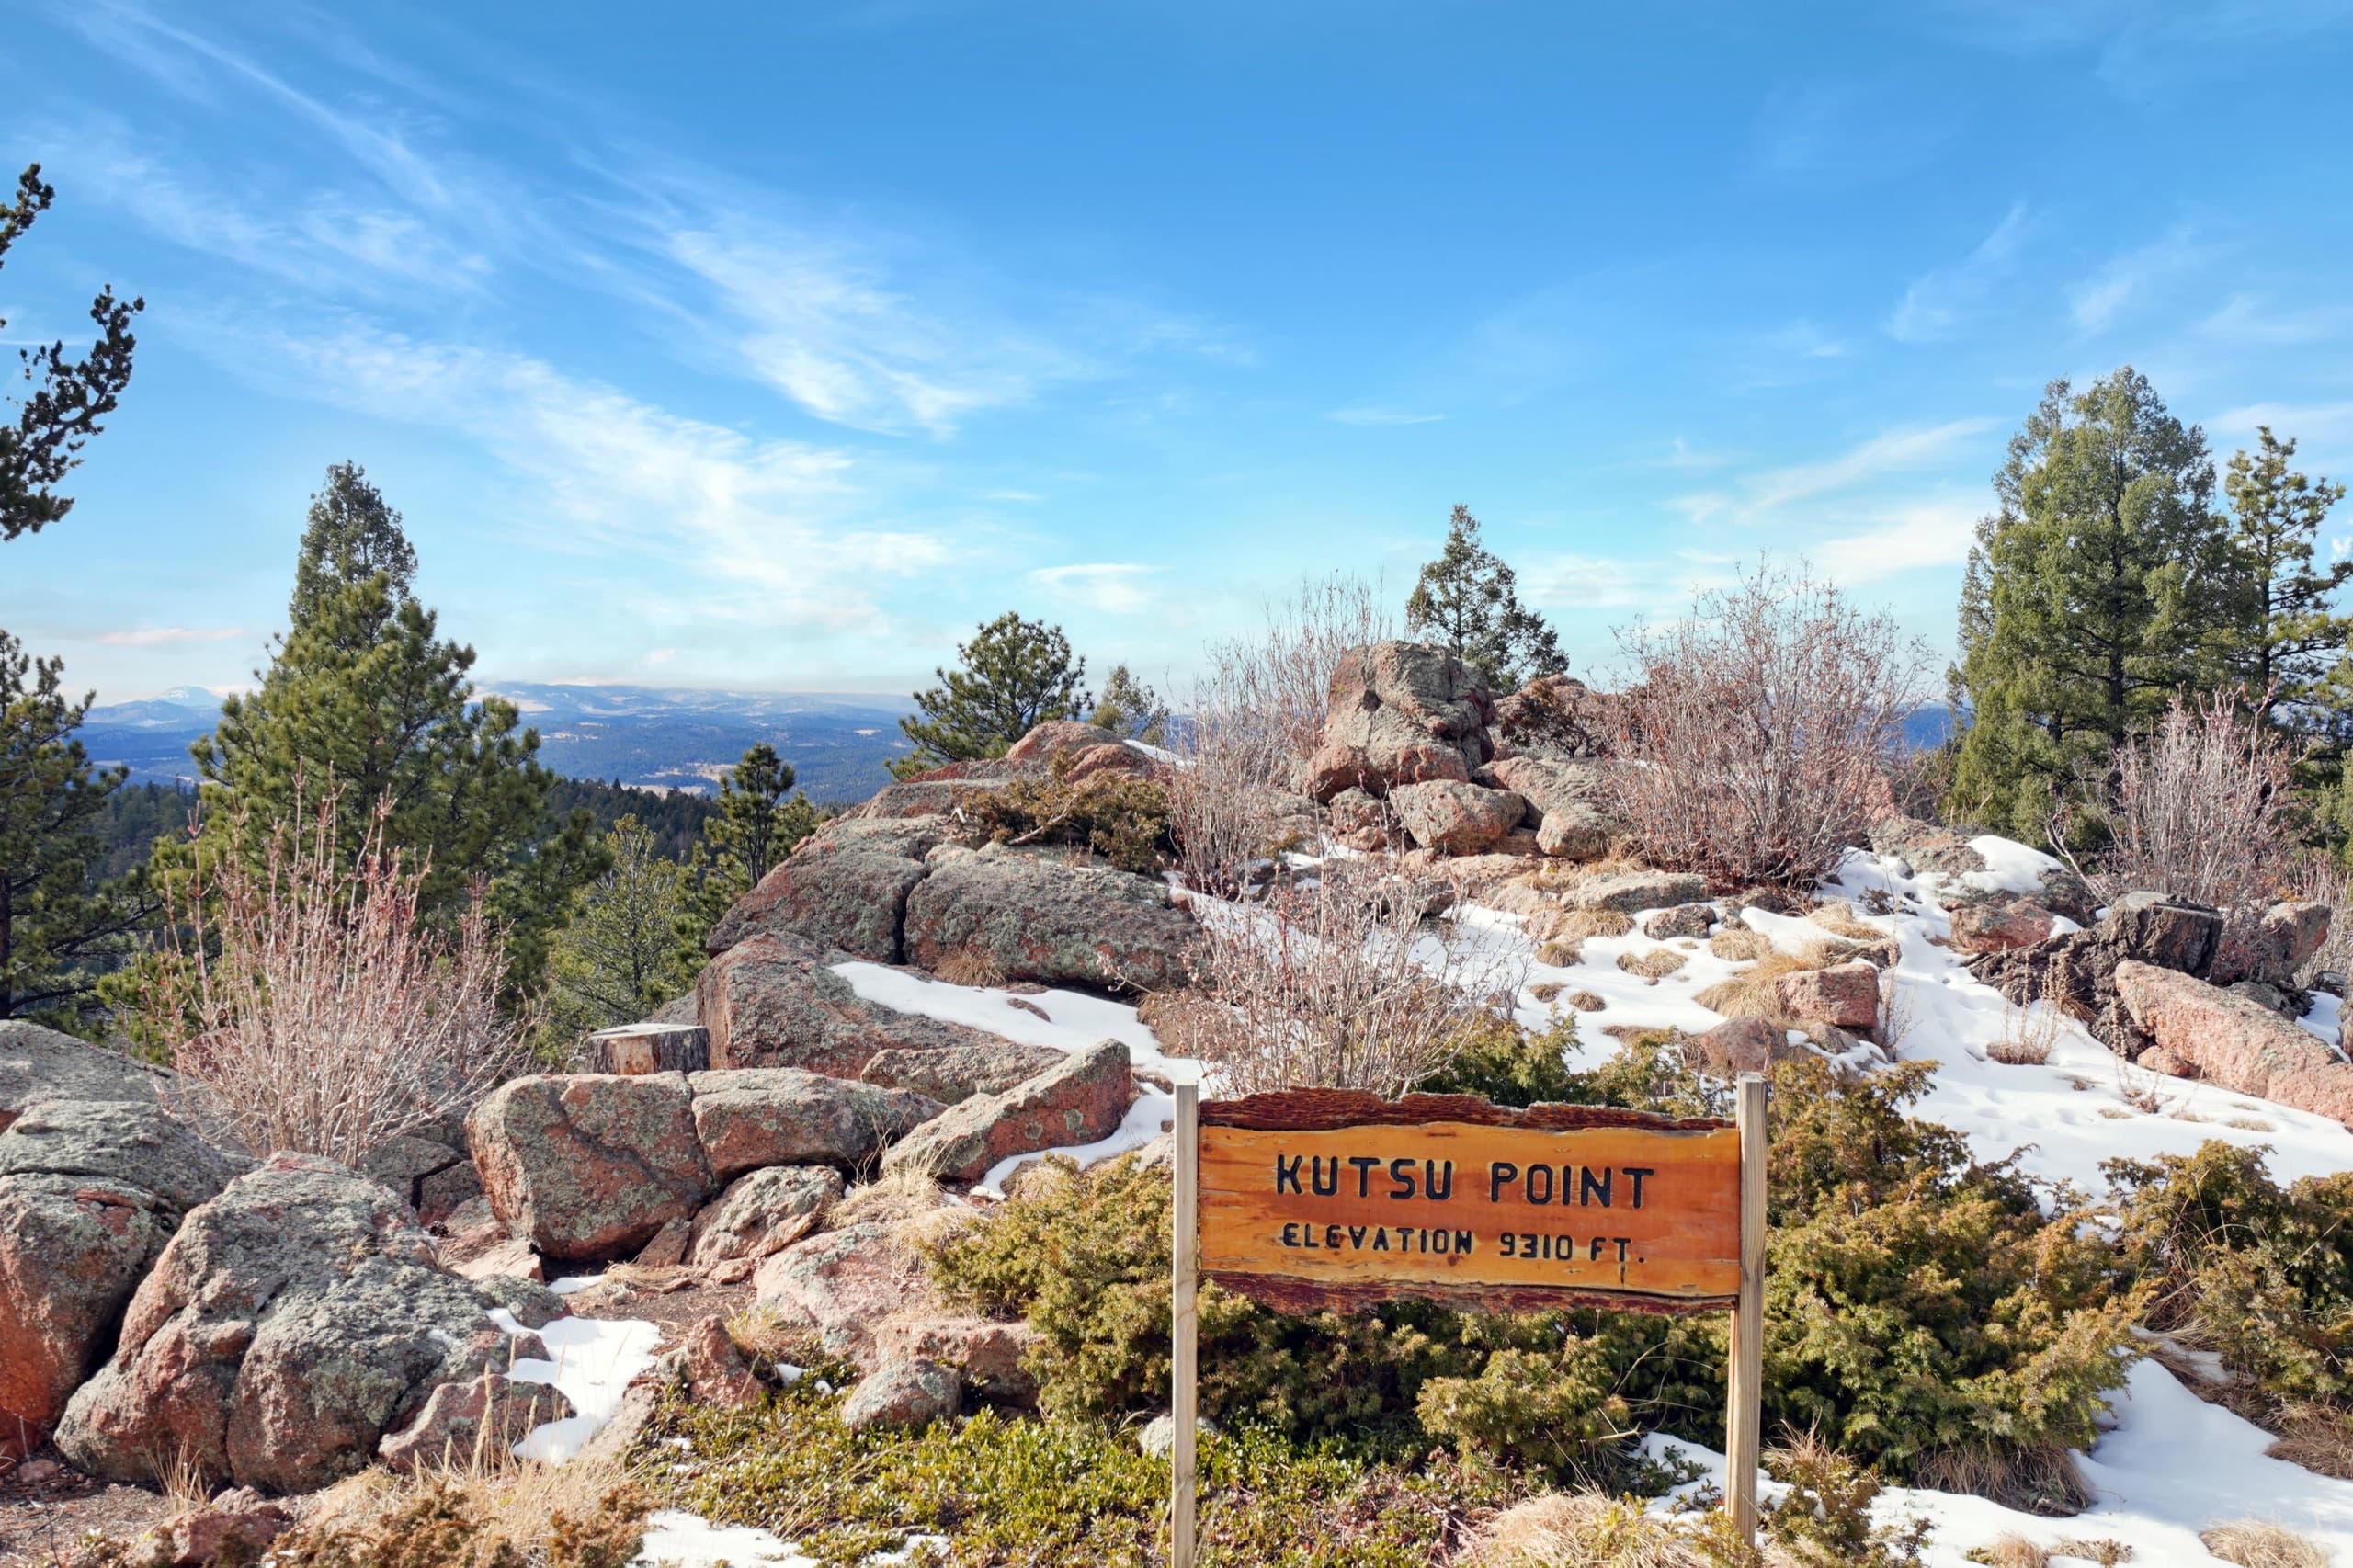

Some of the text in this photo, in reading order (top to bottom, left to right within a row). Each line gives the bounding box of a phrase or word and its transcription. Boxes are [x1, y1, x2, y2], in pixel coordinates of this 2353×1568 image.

[1277, 1154, 1654, 1209] KUTSU POINT
[1283, 1223, 1645, 1263] ELEVATION 9310 FT.
